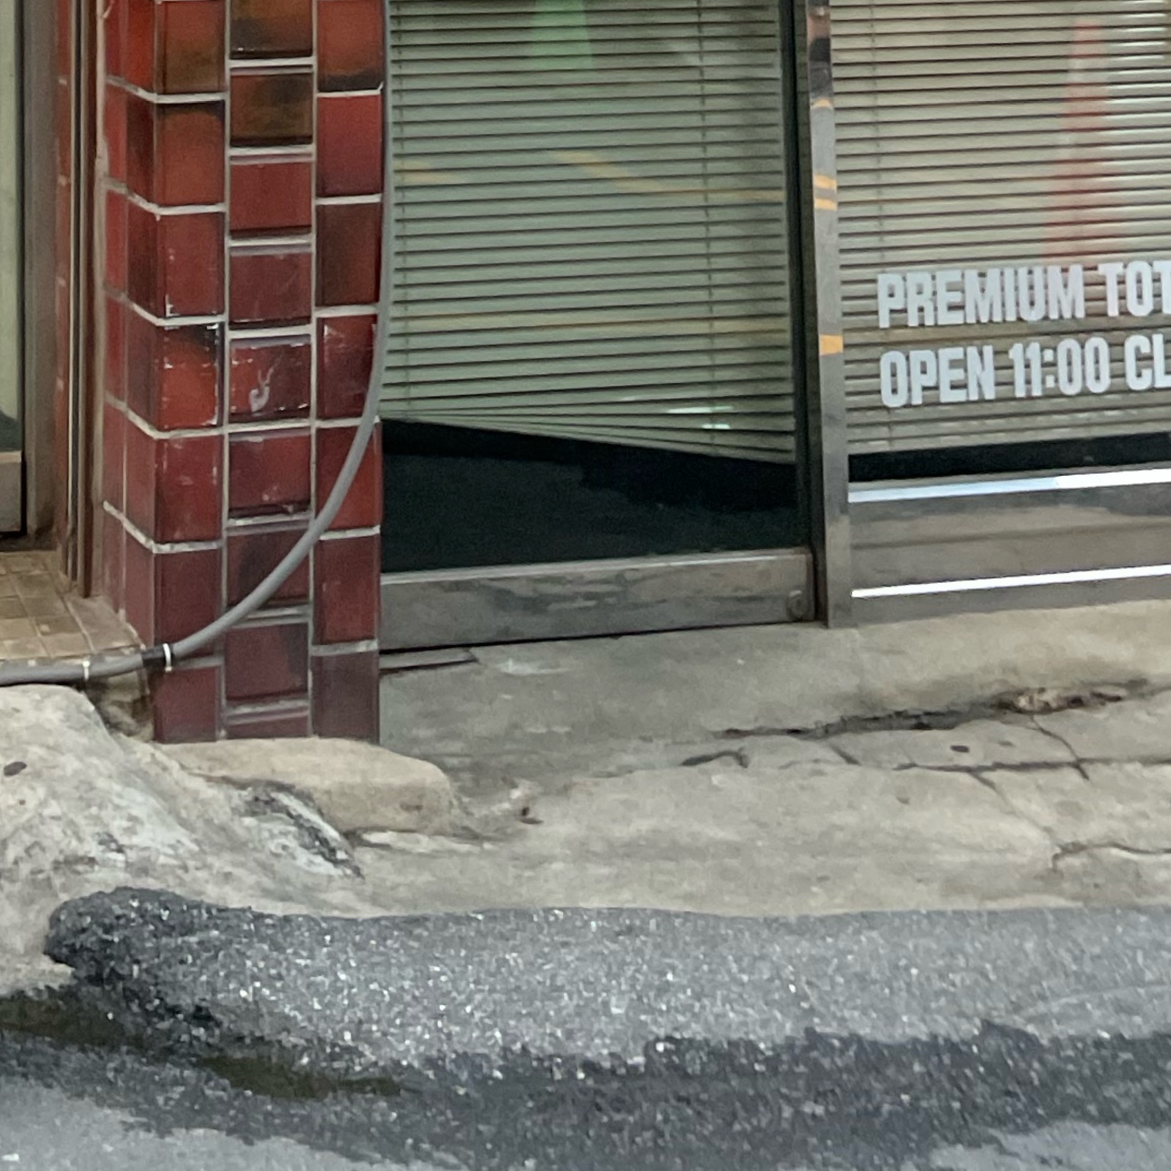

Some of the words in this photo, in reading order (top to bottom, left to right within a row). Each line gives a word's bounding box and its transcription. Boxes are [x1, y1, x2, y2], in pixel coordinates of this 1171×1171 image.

[877, 264, 1086, 329] PREMIUM
[879, 343, 997, 408] OPEN
[1008, 336, 1111, 398] 11:00
[1124, 333, 1171, 392] CL
